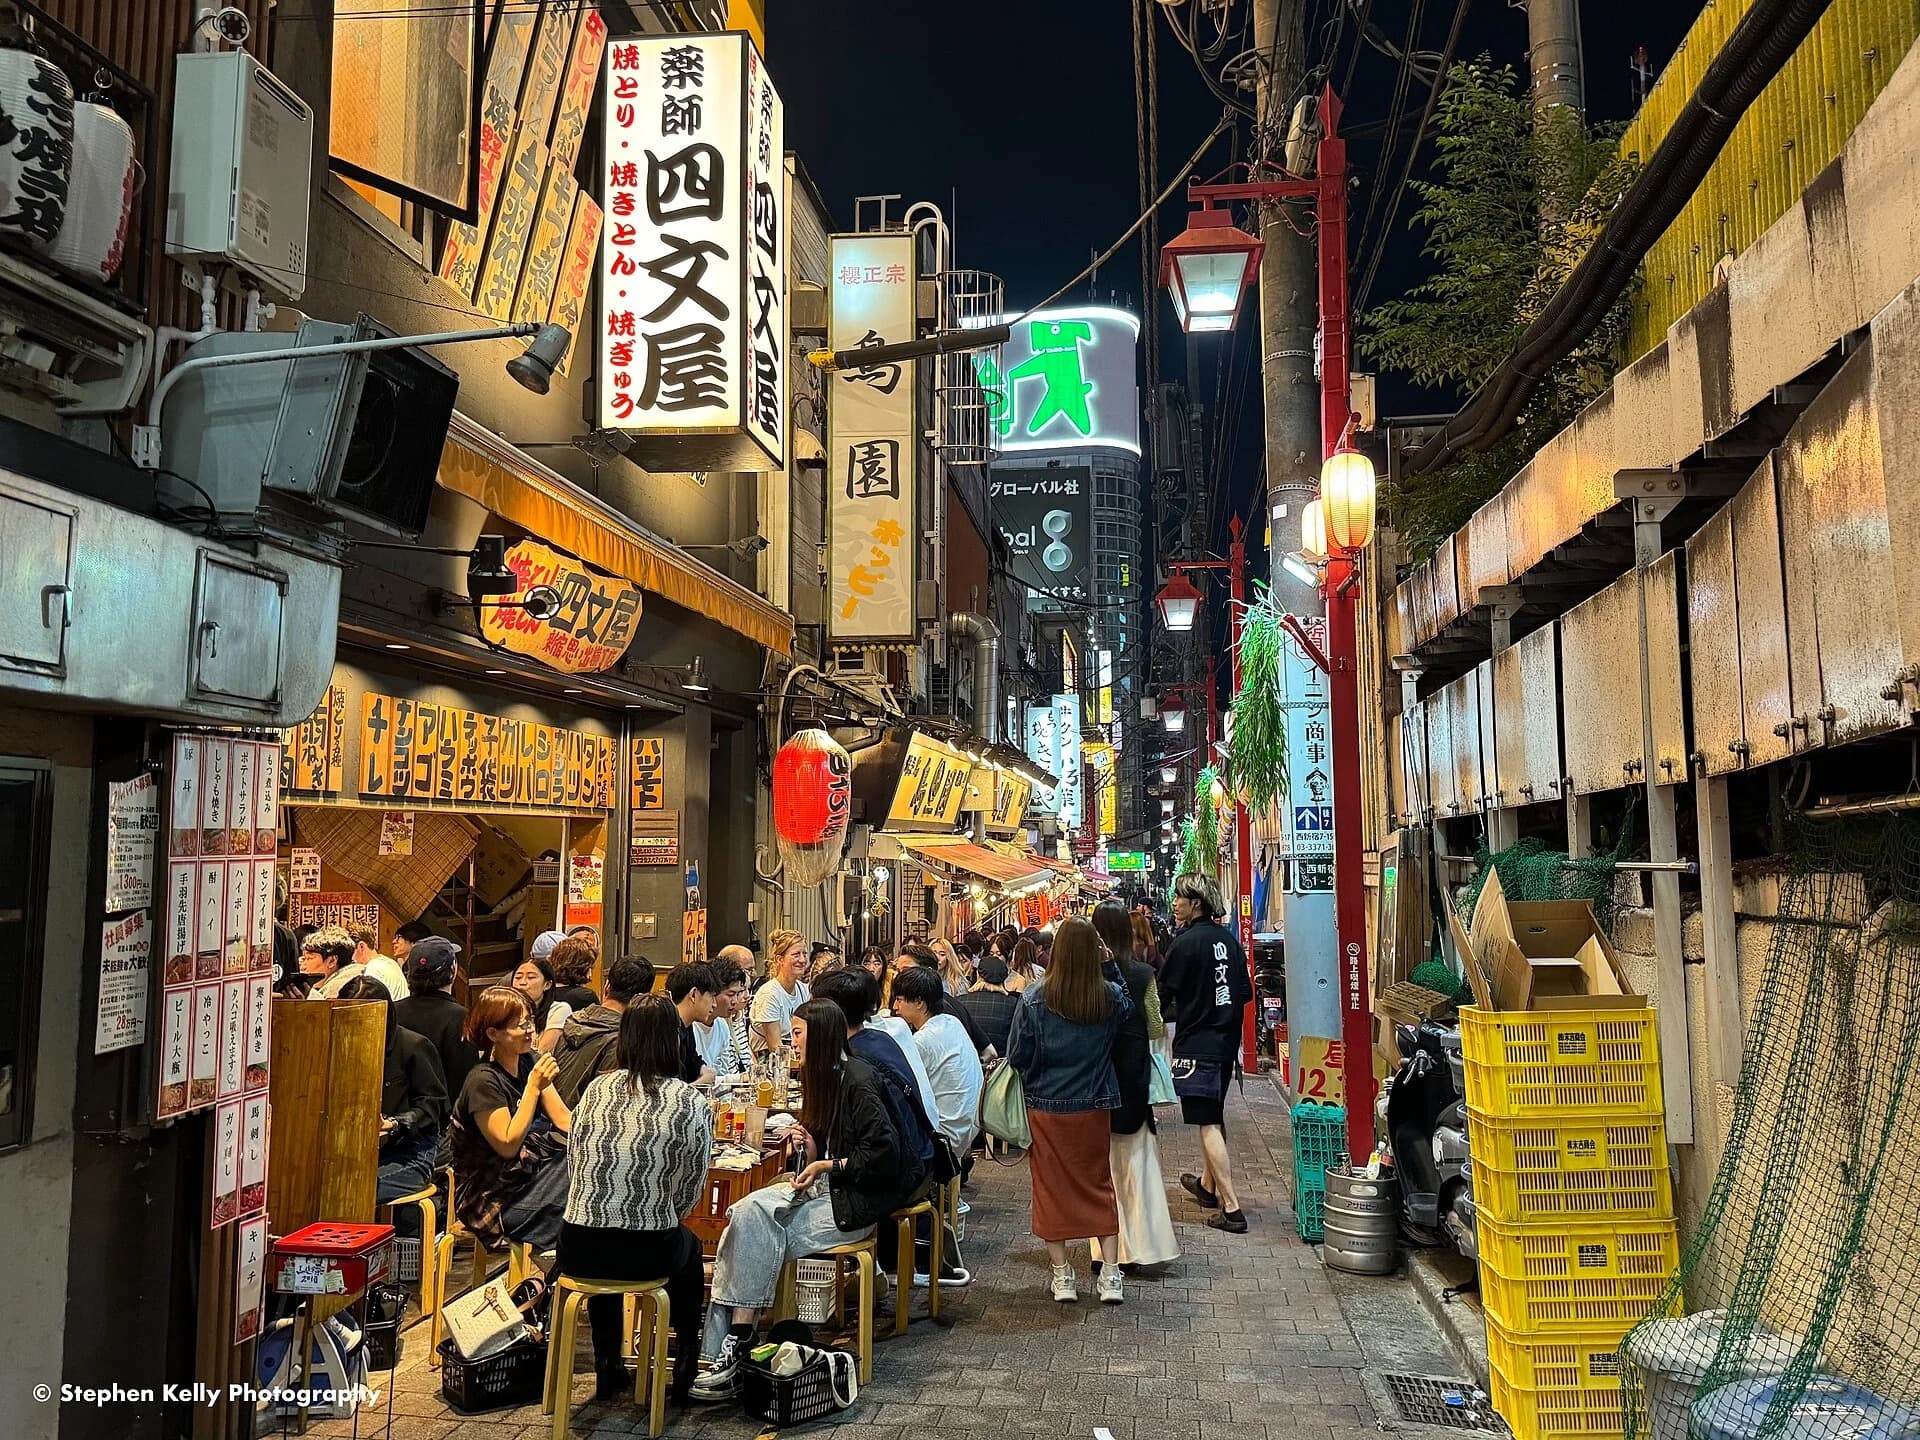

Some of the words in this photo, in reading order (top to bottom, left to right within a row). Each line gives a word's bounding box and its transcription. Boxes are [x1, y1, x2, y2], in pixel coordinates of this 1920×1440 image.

[661, 45, 704, 137] 薬師
[608, 44, 640, 419] 焼とり・焼きとん・焼ぎゅう
[635, 142, 730, 412] 四文屋
[753, 163, 779, 445] 四文屋
[838, 264, 906, 285] 櫻正宗
[990, 480, 1080, 497] グローバル社
[548, 572, 642, 650] 四文屋
[367, 698, 388, 793] チレ
[415, 708, 438, 792] アゴ
[439, 710, 457, 799] ハラミ
[480, 717, 498, 800] 子袋
[500, 720, 518, 799] ガツ
[517, 724, 534, 801] レバ
[535, 730, 550, 800] シロ
[568, 730, 581, 801] ハツ
[581, 738, 597, 804] タン
[634, 739, 662, 808] ハツモト
[211, 749, 222, 822] ししゃも焼き
[239, 751, 249, 828] ポテトサラダ
[264, 753, 273, 814] もつ煮込み
[176, 871, 189, 954] 手羽先唐揚げ
[207, 871, 217, 931] 酎ハイ
[234, 869, 244, 940] ハイボール
[258, 868, 269, 943] センマイ刺し
[102, 955, 150, 975] 未経験者大歓
[1212, 941, 1233, 1007] 四文屋
[1350, 992, 1360, 1010] 禁止
[172, 999, 184, 1075] ビール大瓶
[202, 994, 212, 1055] 冷やっこ
[249, 1104, 260, 1161] 馬刺し
[247, 1229, 258, 1284] キムチ
